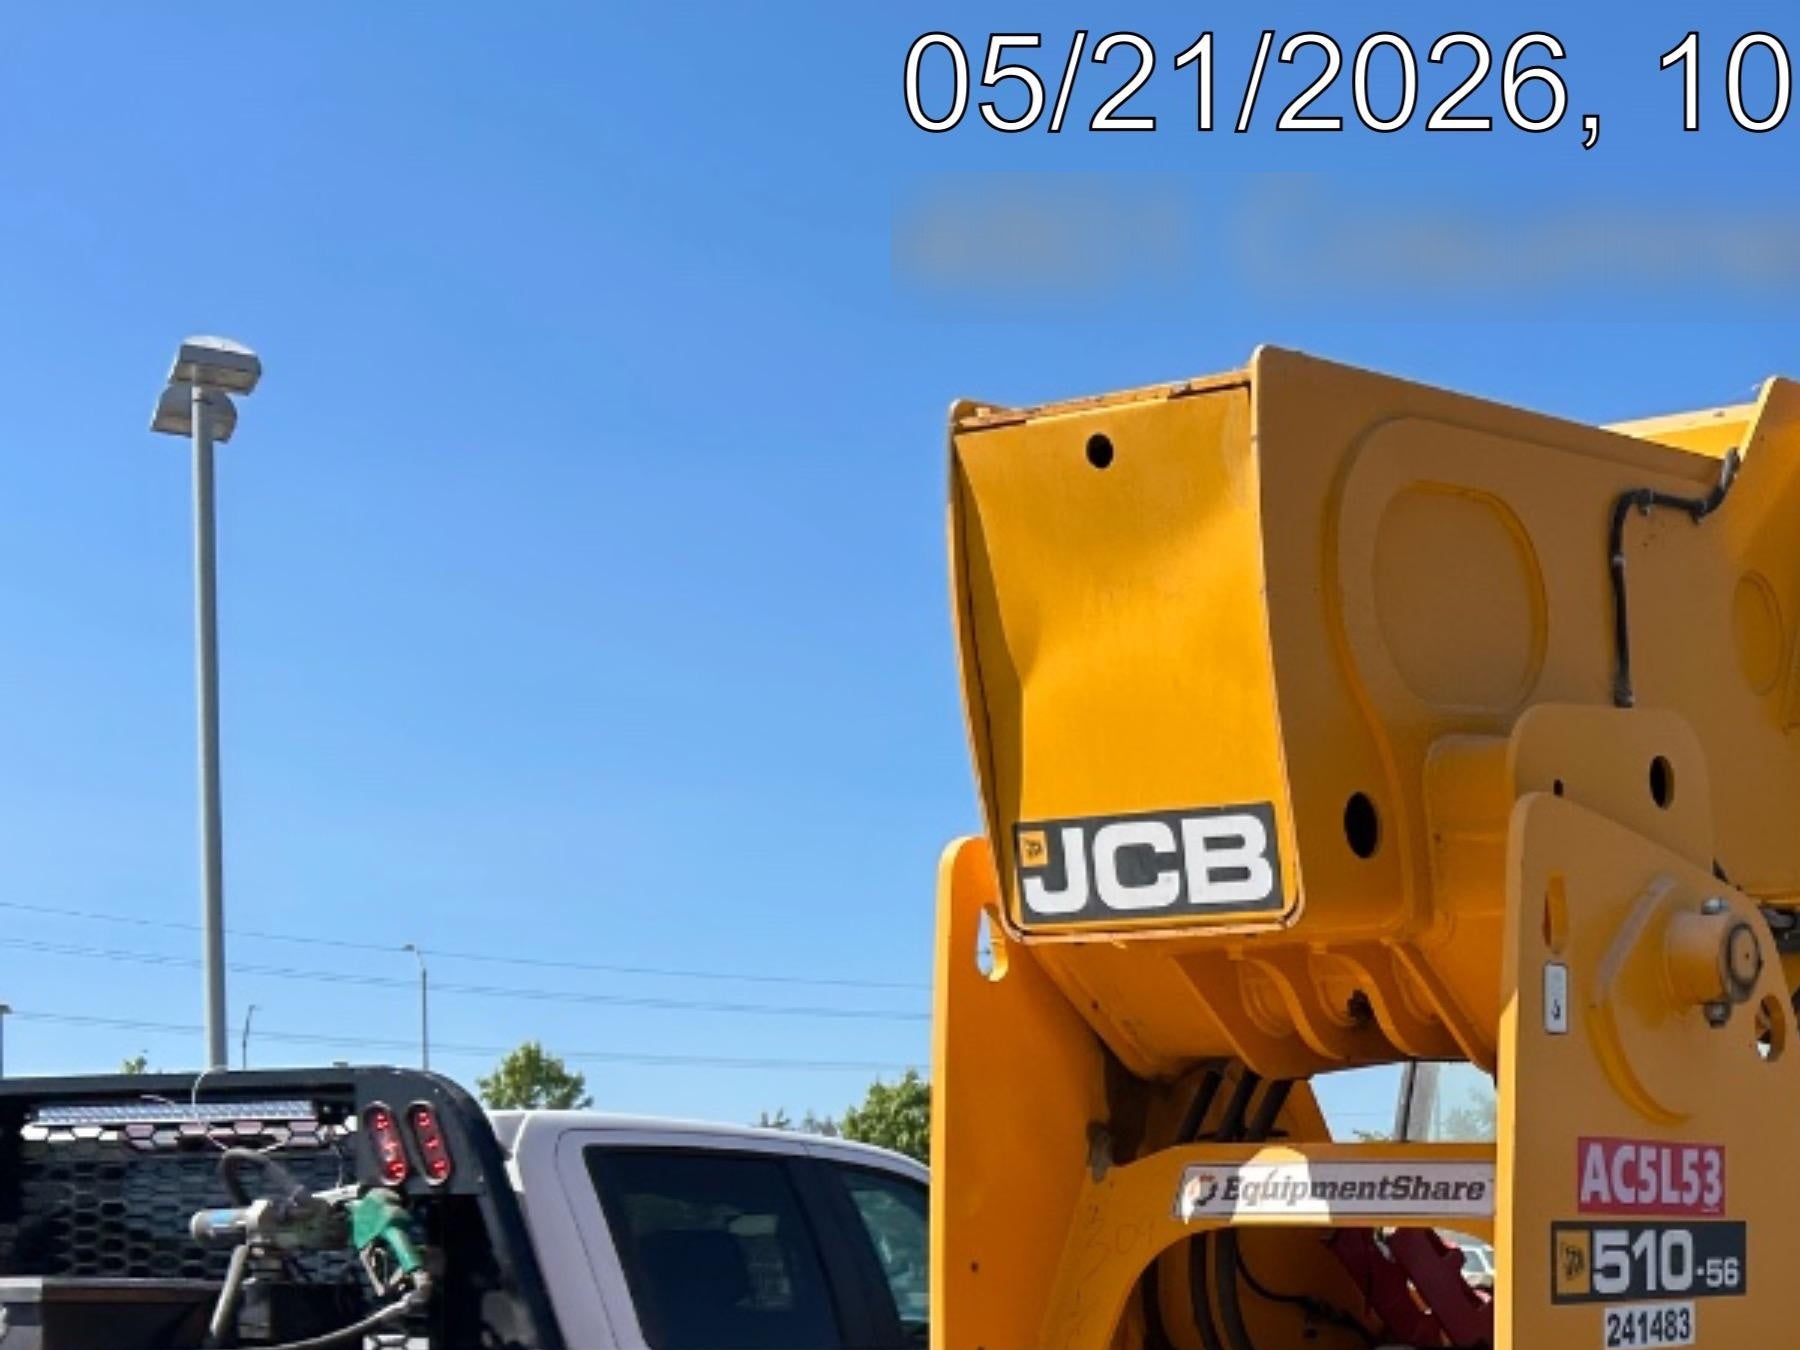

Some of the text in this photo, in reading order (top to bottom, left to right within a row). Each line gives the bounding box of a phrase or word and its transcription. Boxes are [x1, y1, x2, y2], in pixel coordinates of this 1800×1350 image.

[1022, 814, 1274, 914] JCB
[1221, 1168, 1486, 1207] EquipmentShare
[1580, 1142, 1722, 1208] AC5L53
[1607, 1307, 1690, 1347] 241483
